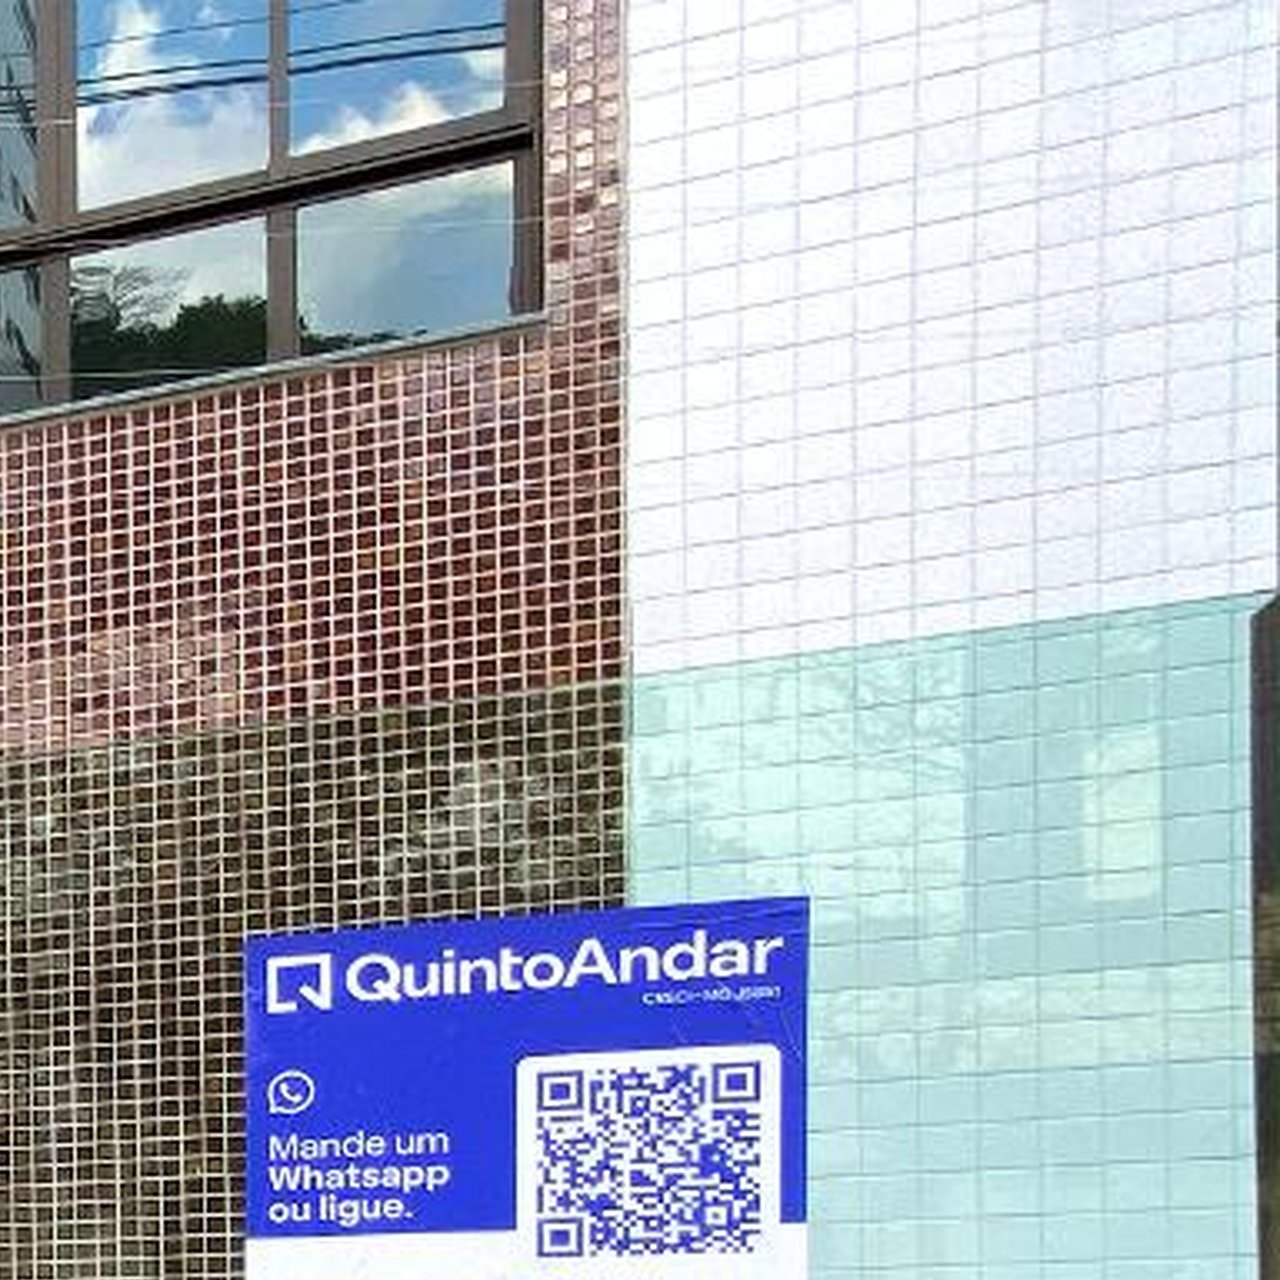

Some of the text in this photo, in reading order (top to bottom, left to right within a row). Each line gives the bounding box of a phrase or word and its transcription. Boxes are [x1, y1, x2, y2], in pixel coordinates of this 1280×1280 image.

[346, 929, 784, 1002] QuintoAndar
[270, 1131, 448, 1160] Mande um
[269, 1163, 449, 1193] Whatsapp
[269, 1194, 412, 1227] ou ligue.
